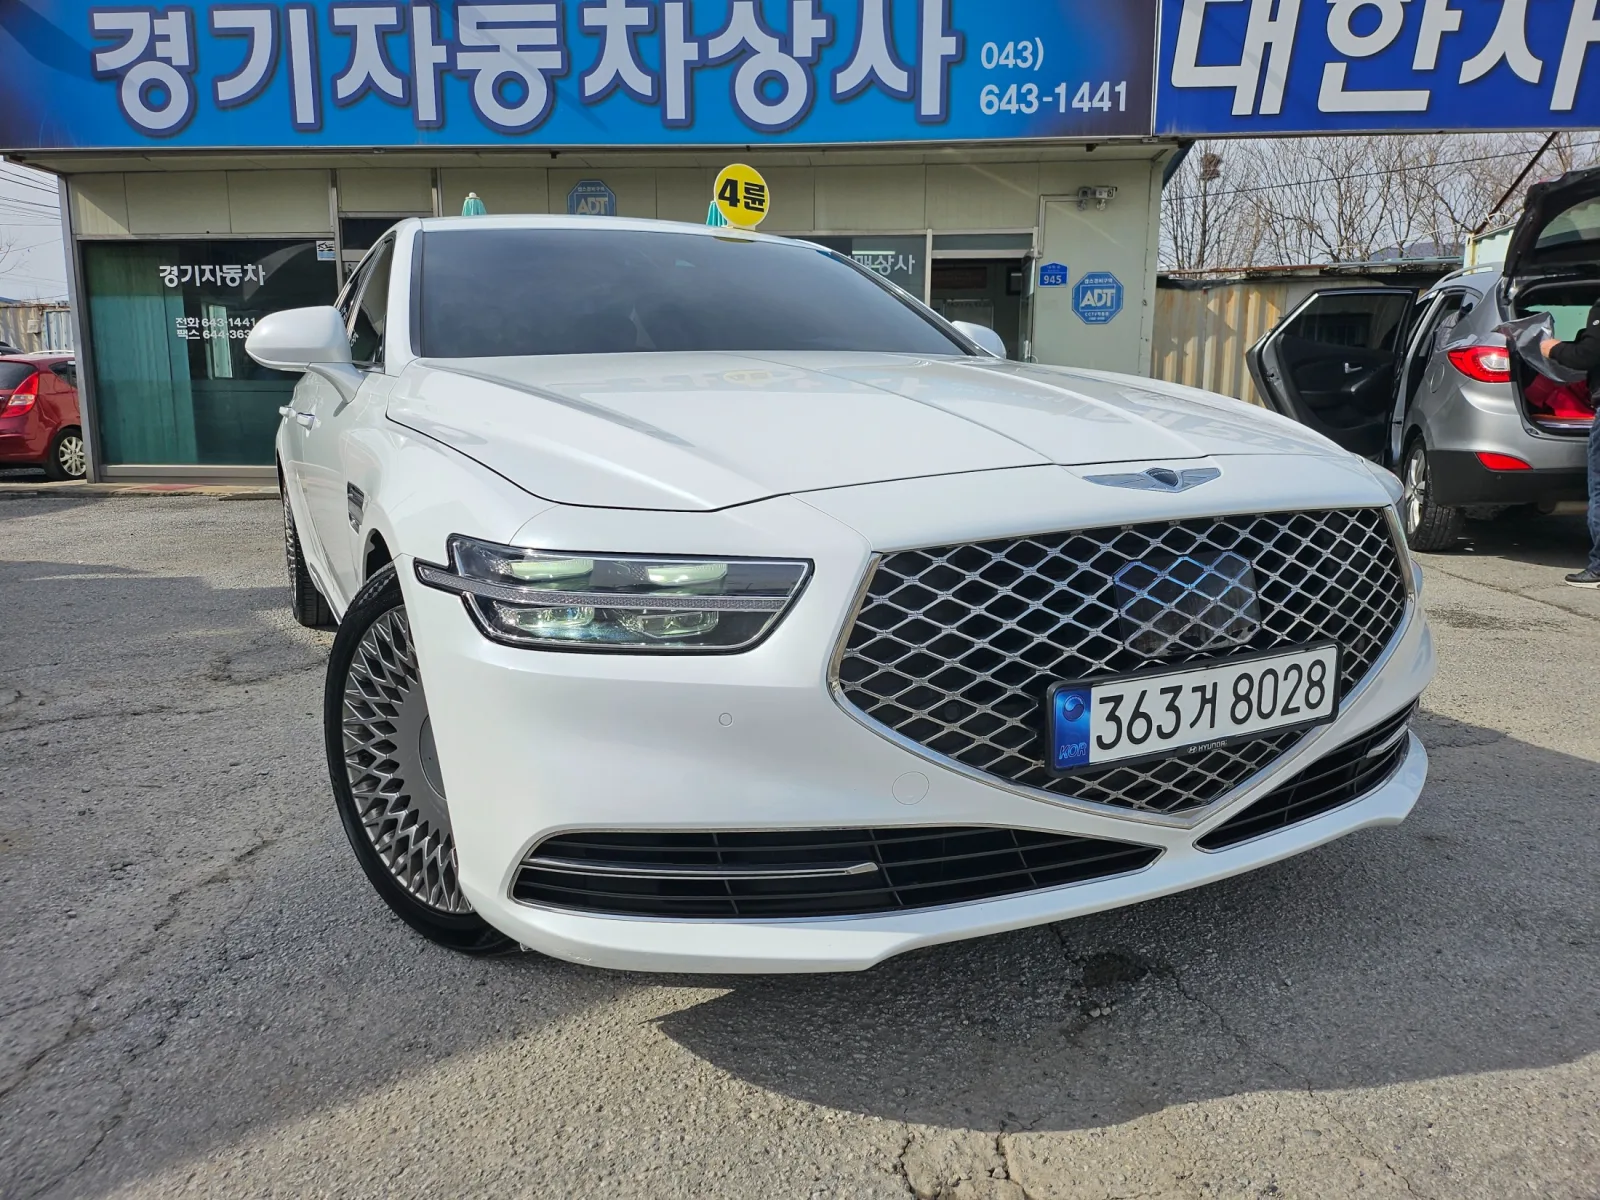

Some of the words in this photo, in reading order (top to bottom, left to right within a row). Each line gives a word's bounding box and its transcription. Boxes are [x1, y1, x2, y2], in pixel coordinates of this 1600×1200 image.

[980, 37, 1044, 71] 043)
[93, 0, 957, 130] 경기자동차상사
[979, 80, 1127, 115] 643-1441
[717, 177, 766, 213] 4륜
[576, 197, 609, 215] ADT
[159, 263, 266, 287] 경기자동차
[848, 254, 916, 275] 매상사
[1043, 275, 1062, 284] 945
[1080, 288, 1116, 307] ADT
[175, 317, 200, 328] 전화
[201, 317, 256, 327] 643-1441
[177, 329, 201, 339] 팩스
[203, 330, 251, 339] 644-363
[1230, 659, 1326, 725] 8028
[1058, 742, 1088, 760] KOR
